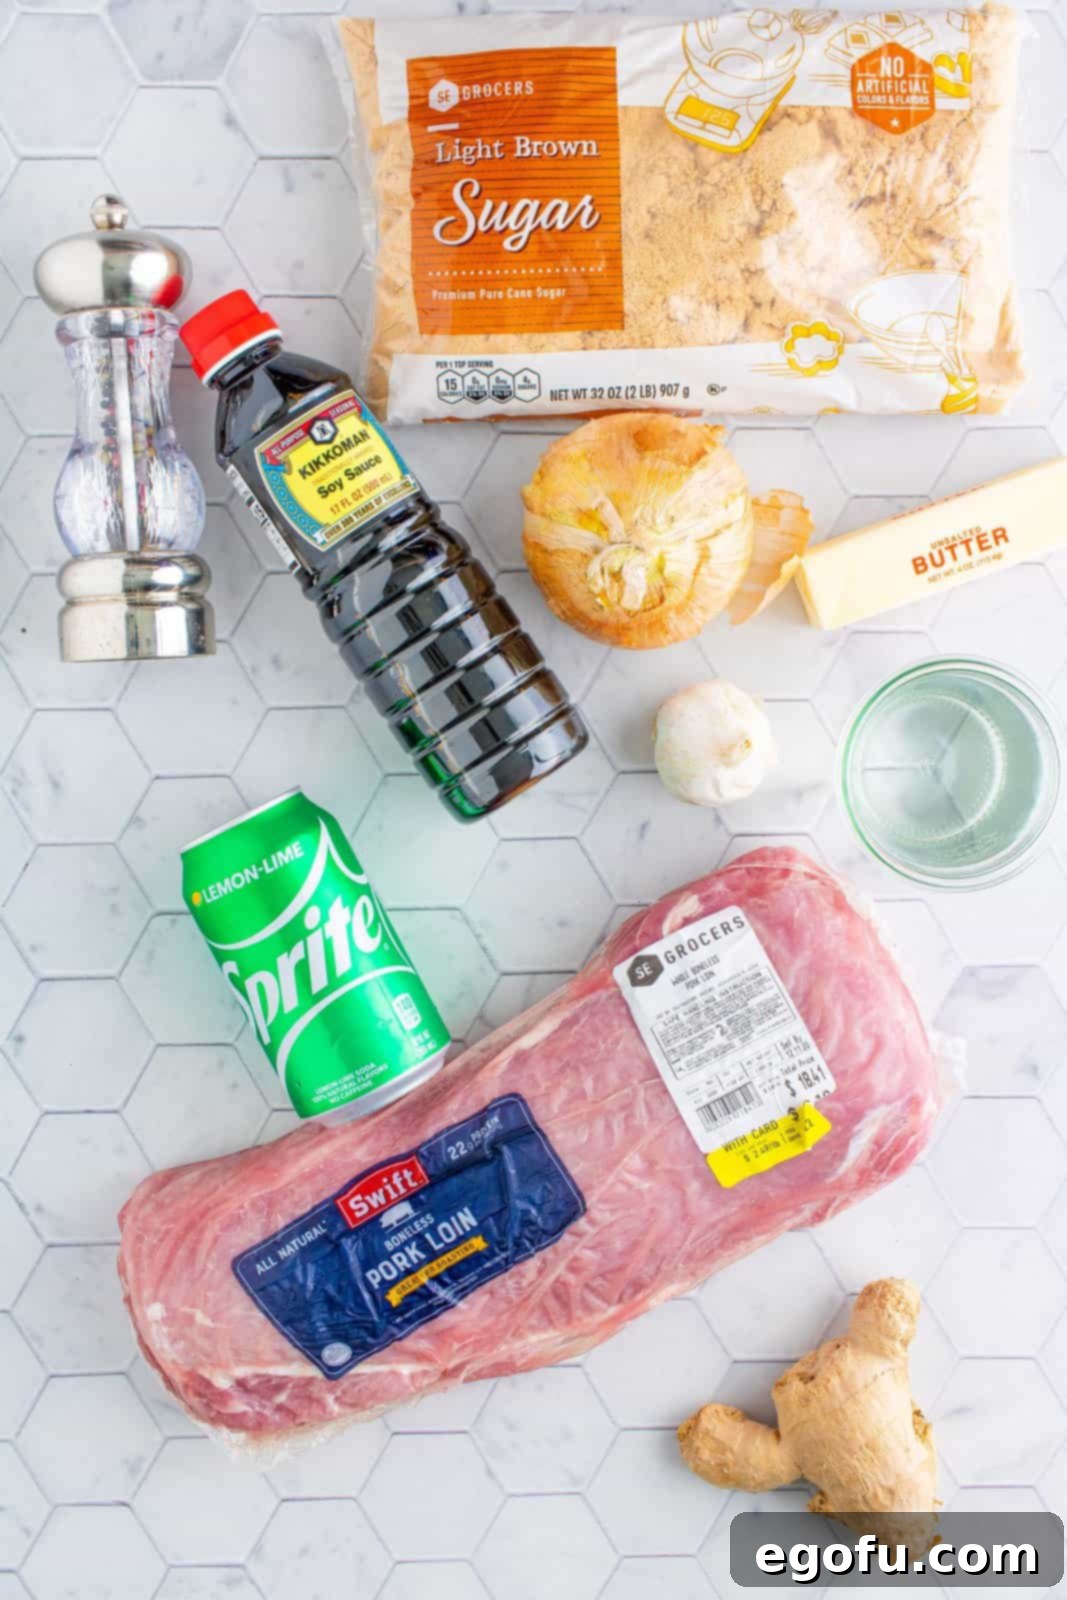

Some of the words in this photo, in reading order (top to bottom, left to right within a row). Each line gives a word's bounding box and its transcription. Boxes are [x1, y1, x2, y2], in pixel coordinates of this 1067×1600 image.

[880, 57, 904, 77] NO
[437, 91, 451, 103] SE
[462, 81, 534, 100] GROCERS
[856, 80, 929, 94] ARTIFICIAL
[857, 95, 886, 104] COLORS
[888, 95, 894, 104] &
[895, 95, 929, 104] FLAVORS
[435, 138, 504, 165] Light
[514, 136, 599, 158] Brown
[432, 178, 600, 252] Sugar
[432, 289, 475, 300] Premium
[479, 288, 503, 299] Pure
[507, 287, 532, 299] Cane
[536, 287, 566, 300] Sugar
[468, 360, 493, 369] SERVING
[445, 379, 457, 390] 15
[550, 389, 568, 401] NET
[572, 388, 588, 400] WT
[591, 387, 604, 399] 32
[608, 386, 621, 398] OZ
[625, 385, 636, 400] (2
[640, 384, 656, 399] LB)
[660, 383, 679, 397] 907
[683, 386, 689, 398] g
[298, 429, 370, 480] KIKKOMAN
[317, 477, 344, 498] Soy
[344, 454, 382, 480] Sauce
[330, 503, 340, 515] 17
[340, 497, 352, 509] FL
[351, 489, 363, 501] OZ
[353, 502, 374, 518] YEARS
[911, 526, 1009, 576] BUTTER
[930, 526, 982, 550] UNSALTED
[202, 841, 305, 904] LEMON-LIME
[635, 963, 653, 980] SE
[664, 915, 745, 965] GROCERS
[222, 895, 382, 1045] Sprite
[355, 1062, 376, 1075] SODA
[357, 1063, 389, 1084] FLAVORS
[784, 1078, 797, 1098] $
[798, 1065, 826, 1090] 18.41
[721, 1136, 748, 1154] WITH
[750, 1119, 779, 1140] CARD
[348, 1167, 418, 1219] Swift
[384, 1213, 435, 1252] BONELESS
[255, 1257, 277, 1276] ALL
[277, 1222, 326, 1259] NATURAL
[365, 1246, 426, 1290] PORK
[425, 1207, 478, 1251] LOIN
